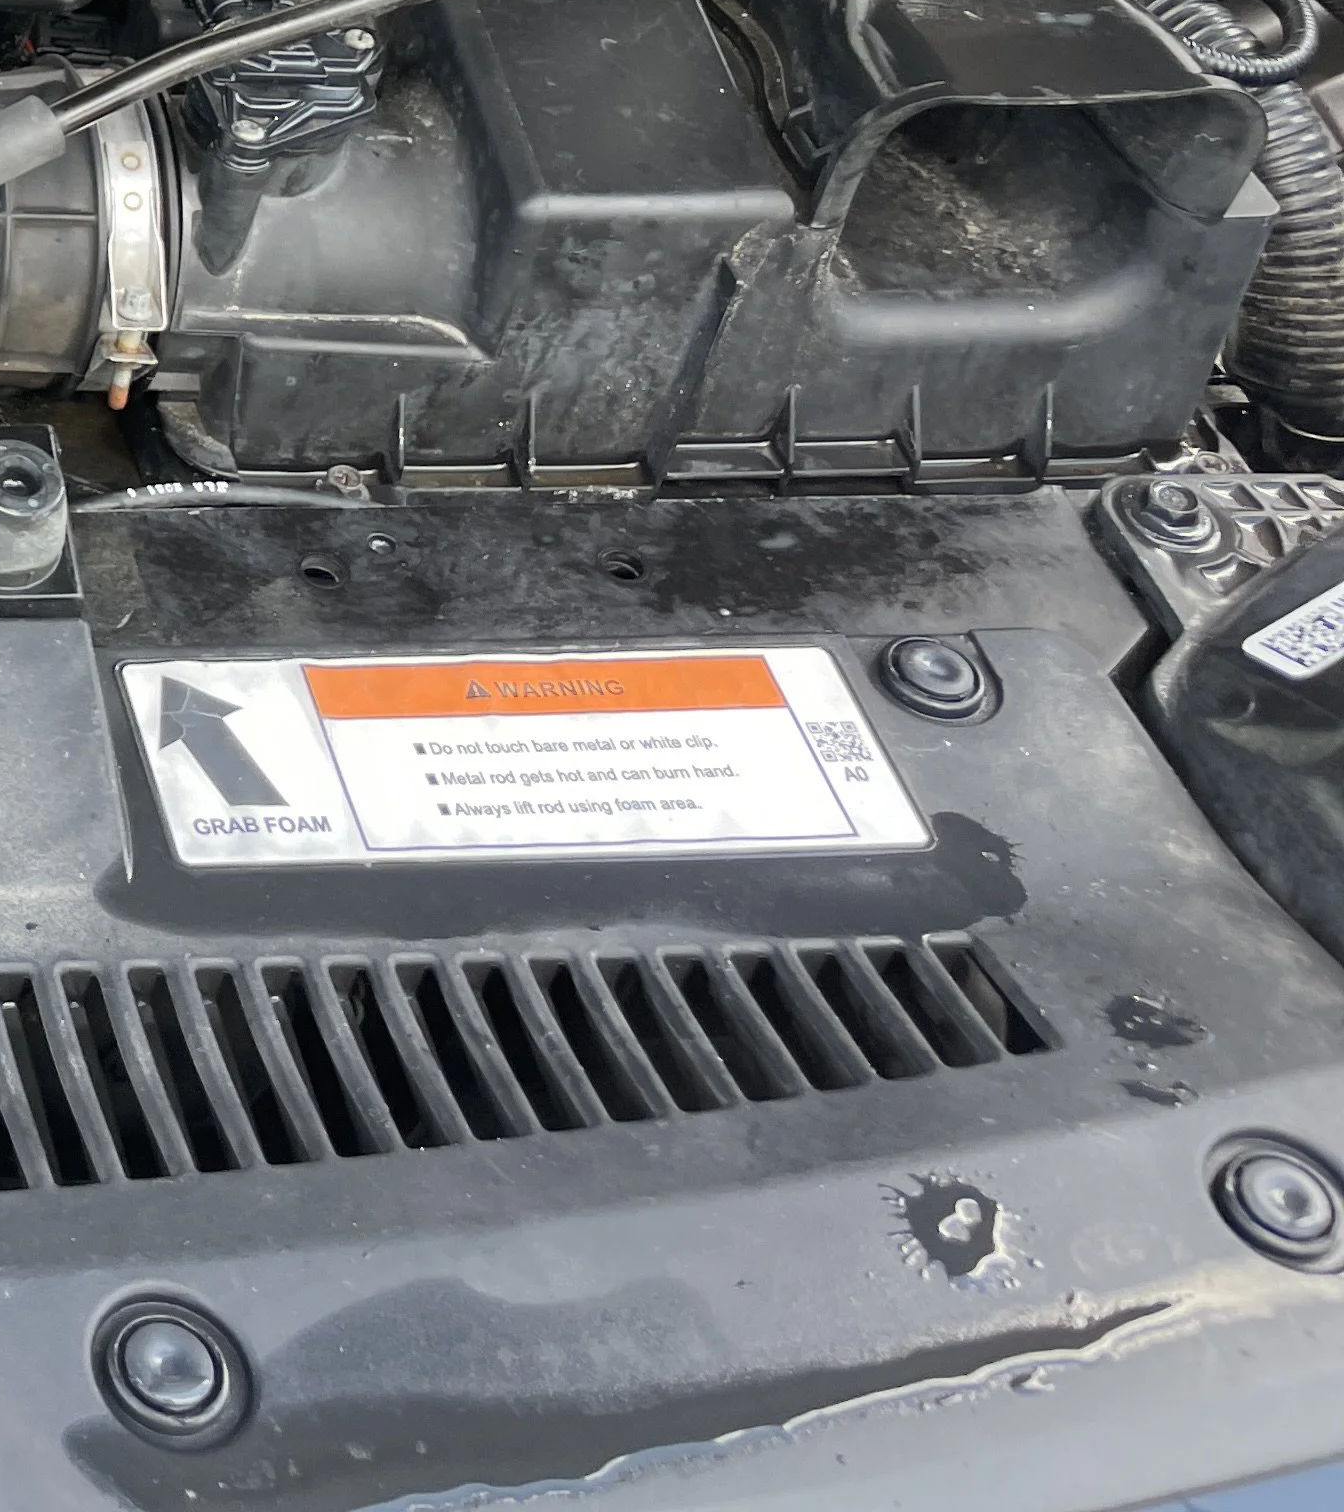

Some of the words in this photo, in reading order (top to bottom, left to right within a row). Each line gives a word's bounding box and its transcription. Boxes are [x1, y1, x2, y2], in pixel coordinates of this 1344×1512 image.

[493, 679, 625, 698] WARNING
[429, 742, 453, 755] Do
[456, 741, 484, 754] not
[485, 740, 530, 754] touch
[531, 738, 569, 753] bare
[572, 737, 617, 751] metal
[619, 739, 636, 750] or
[639, 736, 682, 749] white
[440, 771, 486, 785] Metal
[490, 770, 517, 784] rod
[519, 771, 554, 787] gets
[556, 768, 585, 782] hot
[587, 767, 617, 782] and
[621, 768, 651, 780] can
[652, 766, 691, 780] burn
[692, 763, 740, 778] hand.
[455, 801, 512, 819] Always
[513, 800, 536, 815] lift
[537, 800, 565, 814] rod
[568, 798, 613, 815] using
[614, 797, 657, 811] foam
[659, 798, 703, 811] area.
[192, 816, 260, 835] GRAB
[263, 815, 332, 834] FOAM
